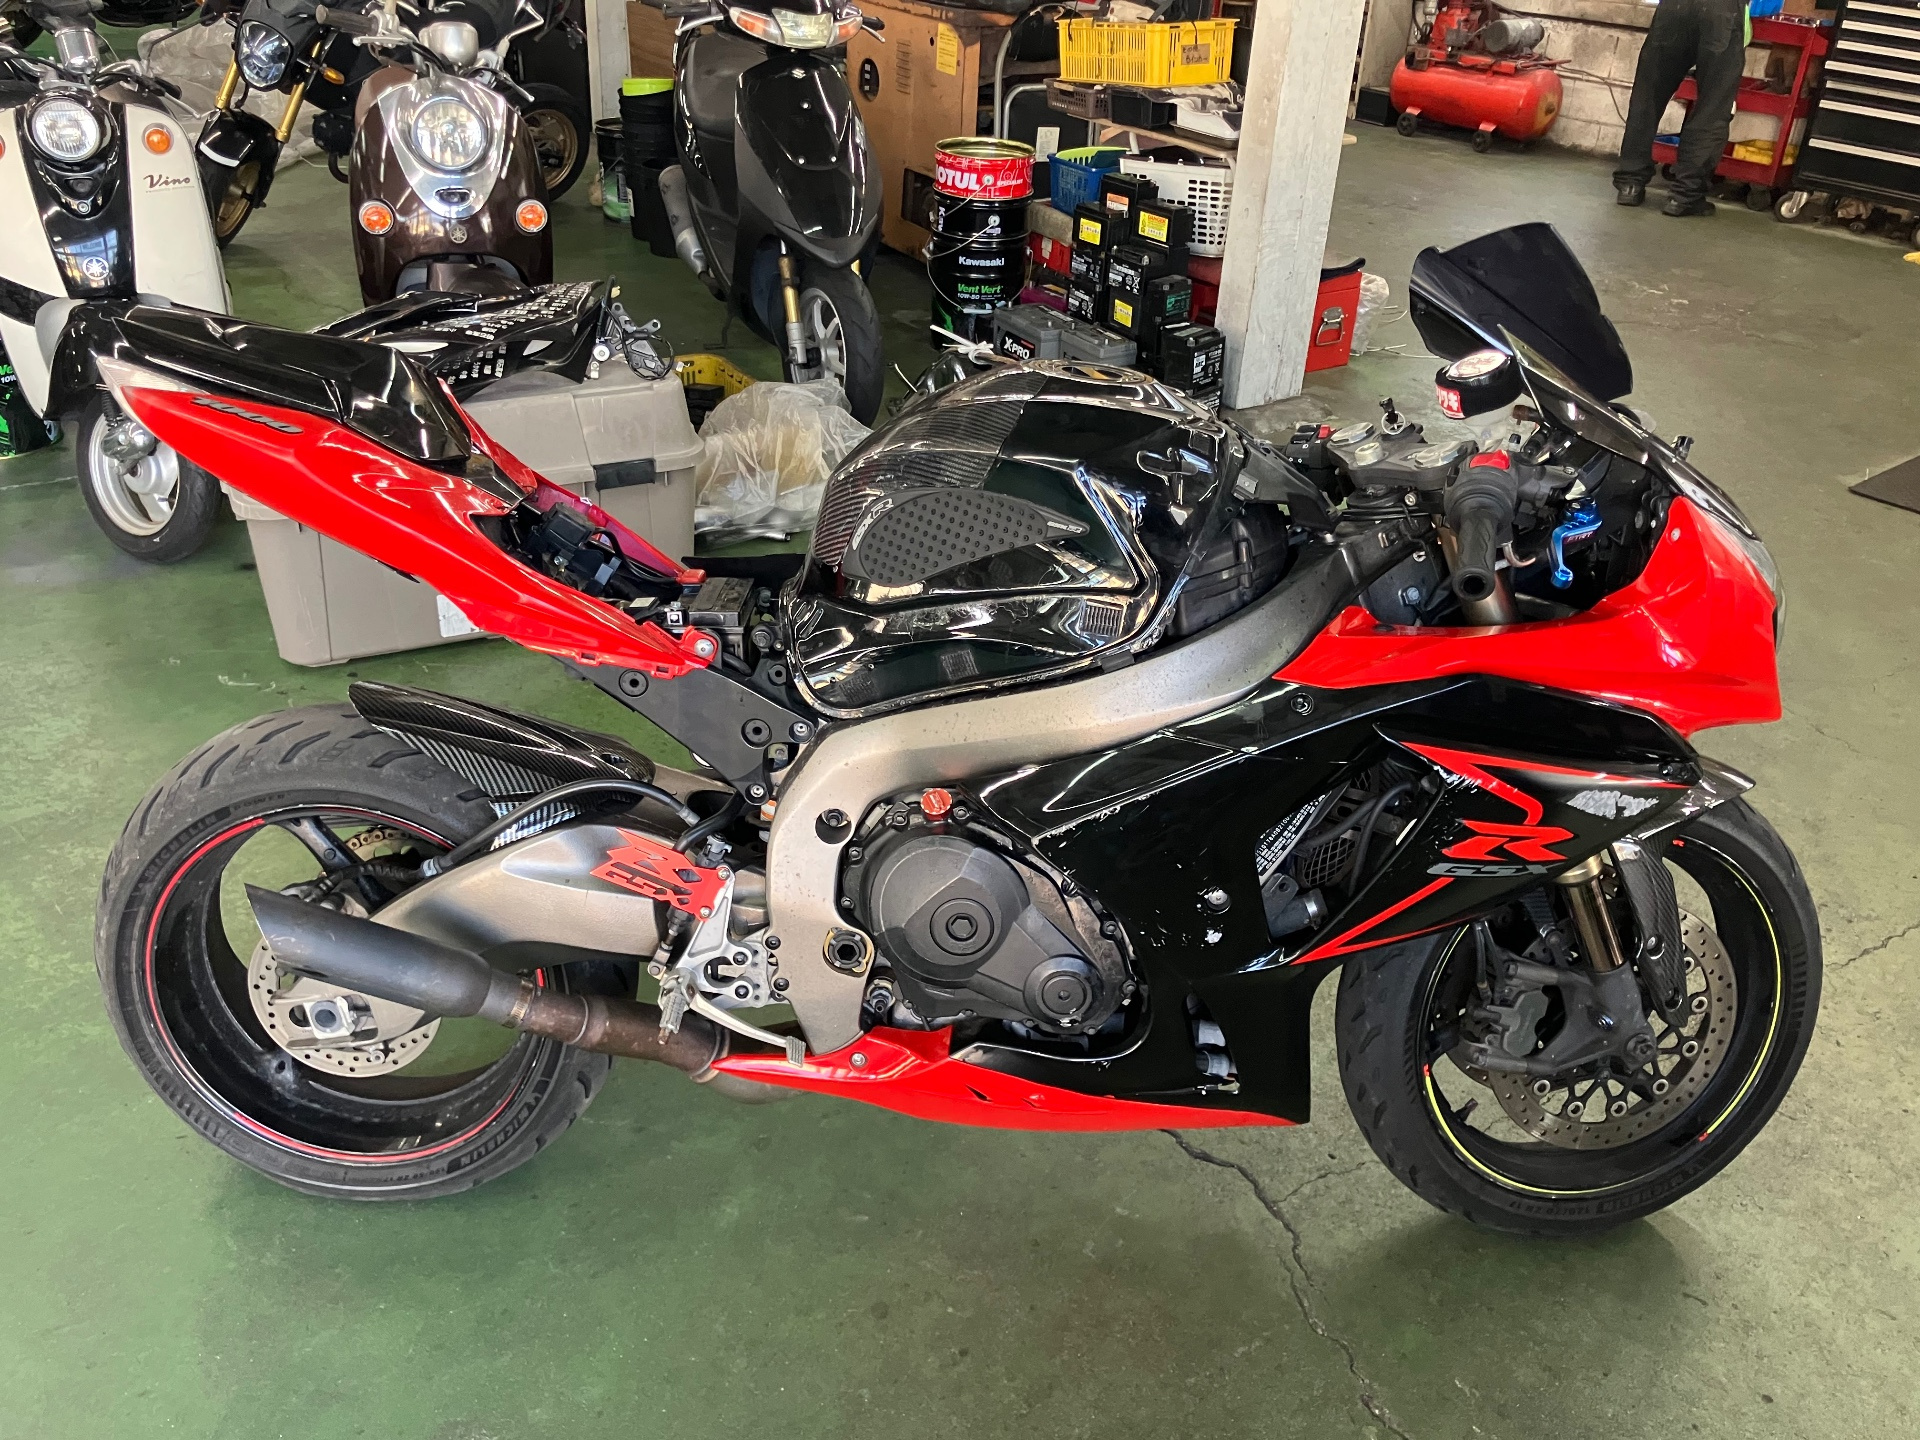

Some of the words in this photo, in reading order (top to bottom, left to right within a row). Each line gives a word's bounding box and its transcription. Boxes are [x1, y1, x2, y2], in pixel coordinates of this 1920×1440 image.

[143, 174, 191, 188] Vino
[936, 164, 980, 190] OTUL
[958, 256, 1005, 267] Kawasaki
[957, 283, 980, 294] Vent
[981, 285, 1001, 294] Vert
[190, 396, 304, 435] 1000
[1426, 860, 1566, 878] GSX
